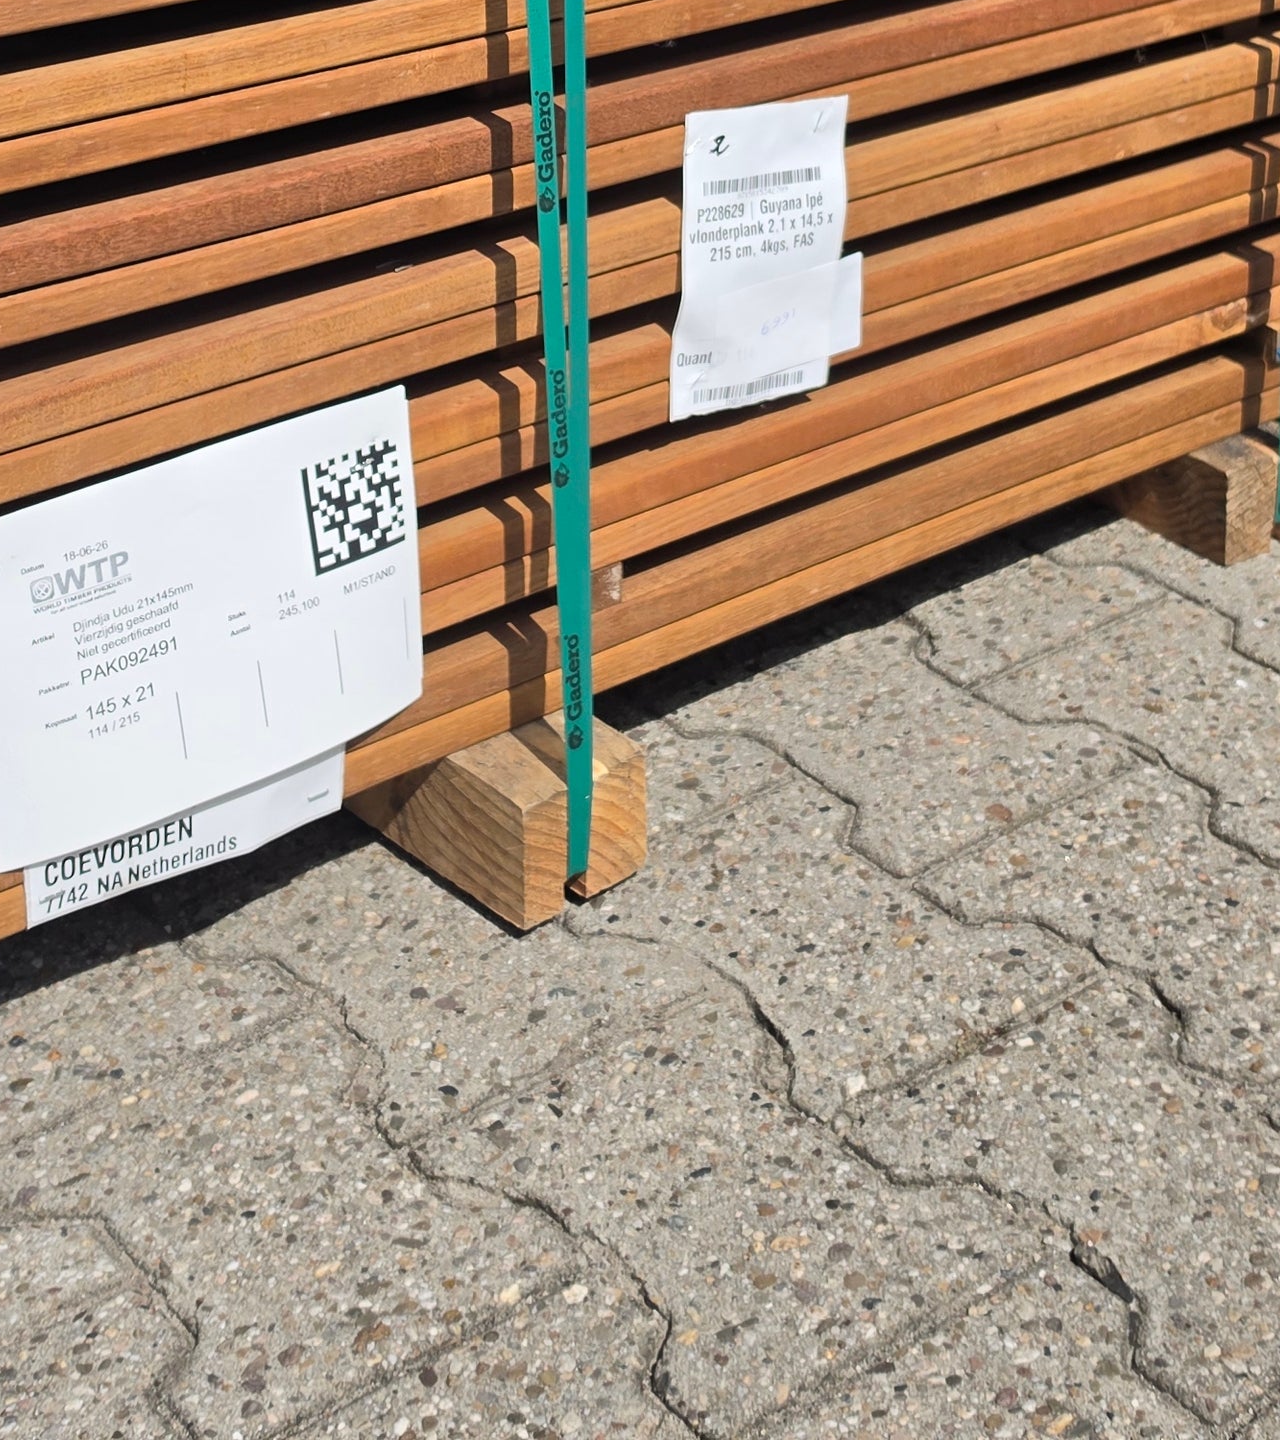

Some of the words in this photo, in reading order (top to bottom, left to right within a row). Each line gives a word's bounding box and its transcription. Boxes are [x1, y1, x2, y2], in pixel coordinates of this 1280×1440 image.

[536, 92, 556, 184] Gadero
[689, 220, 764, 244] vlonderplank
[790, 218, 796, 230] x
[827, 213, 833, 224] x
[697, 202, 745, 223] P228629
[760, 197, 802, 215] Guyana
[806, 192, 823, 212] Ipé
[710, 245, 732, 262] 215
[793, 232, 815, 248] FAS
[552, 369, 568, 458] Gadero
[20, 563, 45, 575] Datum
[63, 540, 109, 562] 18-06-26
[54, 551, 129, 595] WTP
[31, 633, 55, 646] Artikel
[73, 613, 110, 633] Djindja
[113, 603, 135, 619] Udu
[137, 582, 194, 610] 21x145mm
[33, 600, 62, 615] WORLD
[63, 590, 92, 605] TIMBER
[277, 589, 296, 604] 114
[279, 596, 320, 620] 245,100
[343, 564, 396, 595] M1/STAND
[74, 622, 123, 646] Vierzijdig
[126, 600, 179, 628] geschaafd
[76, 645, 99, 660] Niet
[100, 618, 171, 654] gecertificeerd
[80, 636, 178, 685] PAK092491
[566, 634, 582, 721] Gadero
[86, 697, 117, 720] 145
[122, 695, 131, 708] x
[135, 682, 155, 702] 21
[88, 724, 108, 739] 114
[119, 711, 141, 728] 215
[44, 815, 193, 887] COEVORDEN
[97, 871, 123, 895] NA
[128, 834, 238, 885] Netherlands
